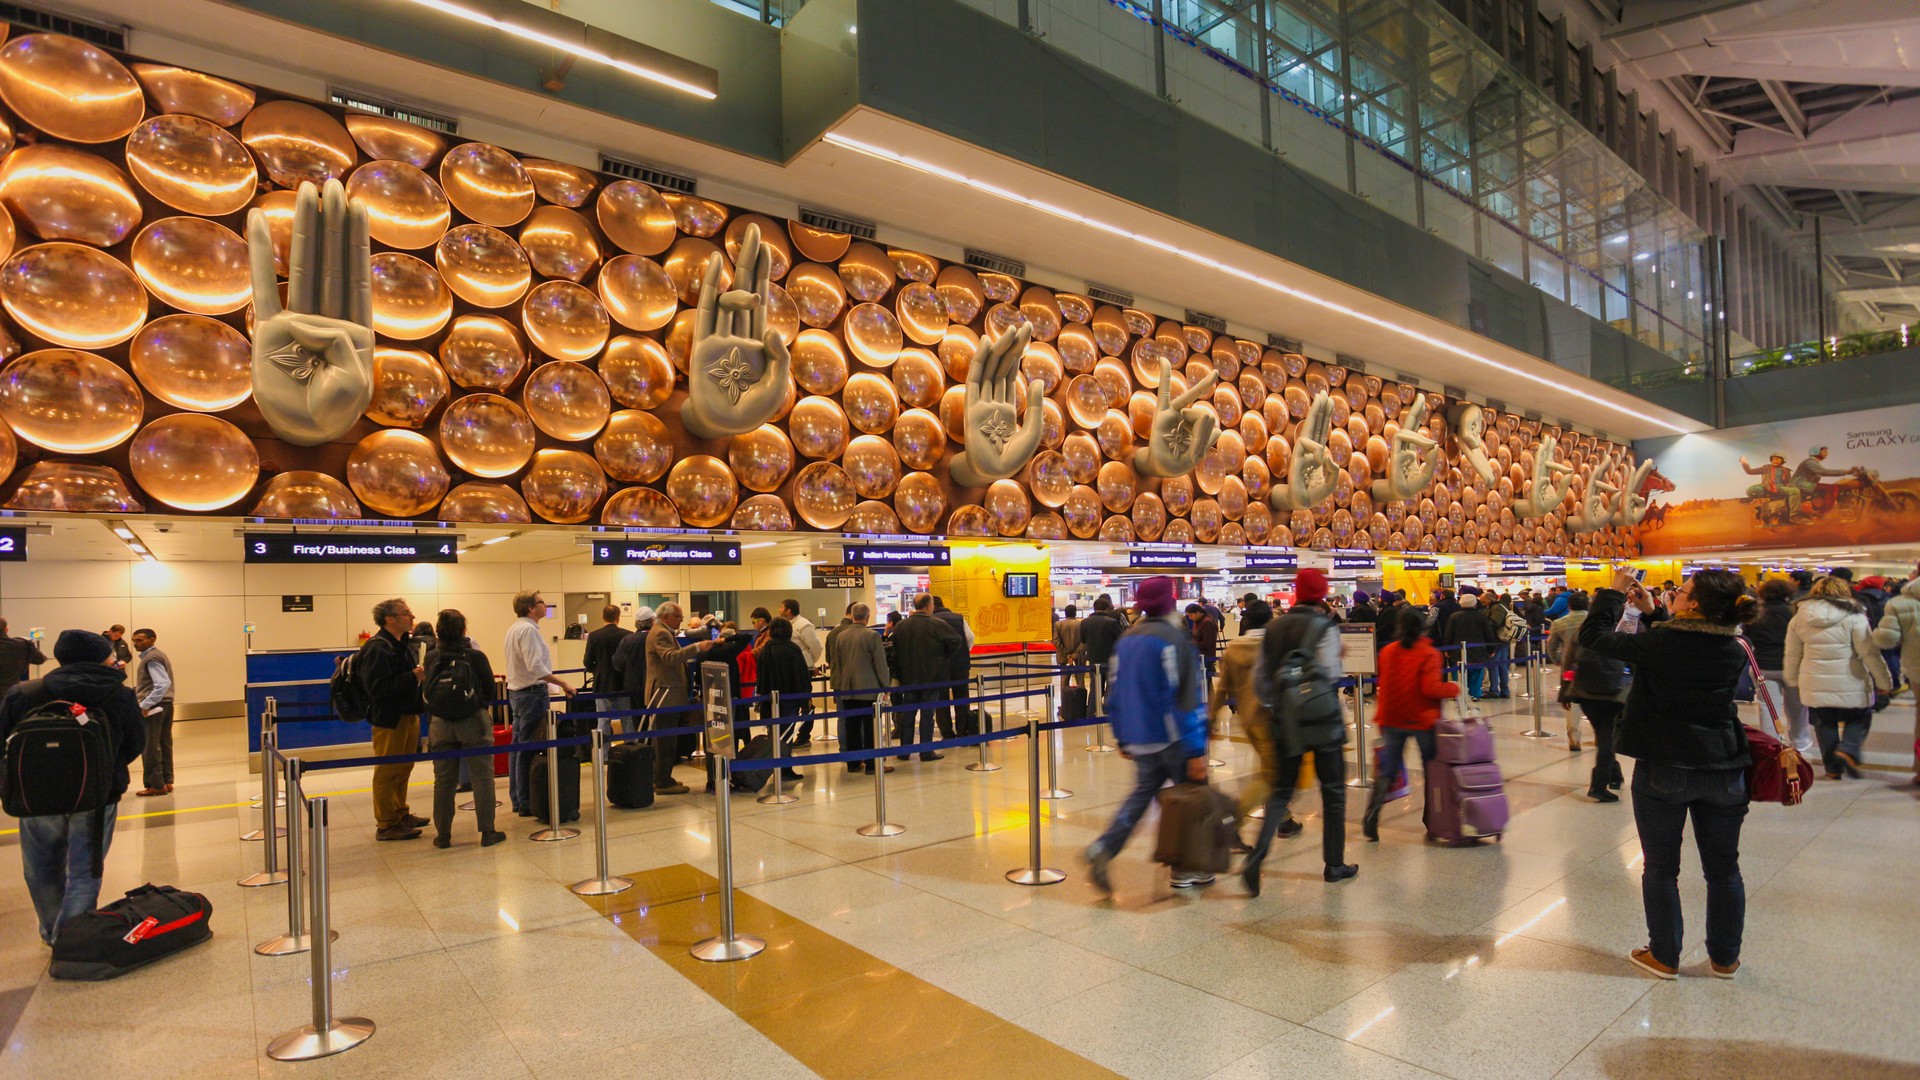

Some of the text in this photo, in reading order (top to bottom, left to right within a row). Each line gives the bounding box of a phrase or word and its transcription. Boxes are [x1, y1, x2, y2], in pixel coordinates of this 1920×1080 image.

[1846, 428, 1892, 439] Samsung
[1846, 433, 1908, 450] GALAXY
[0, 537, 14, 551] 2
[254, 542, 450, 556] 3 First/Business Class 4
[600, 548, 737, 559] 5 First/Business Class 6
[848, 551, 948, 560] 7 Indian Passport Holders 8
[707, 703, 727, 714] BUSINESS
[711, 720, 725, 730] CLASS
